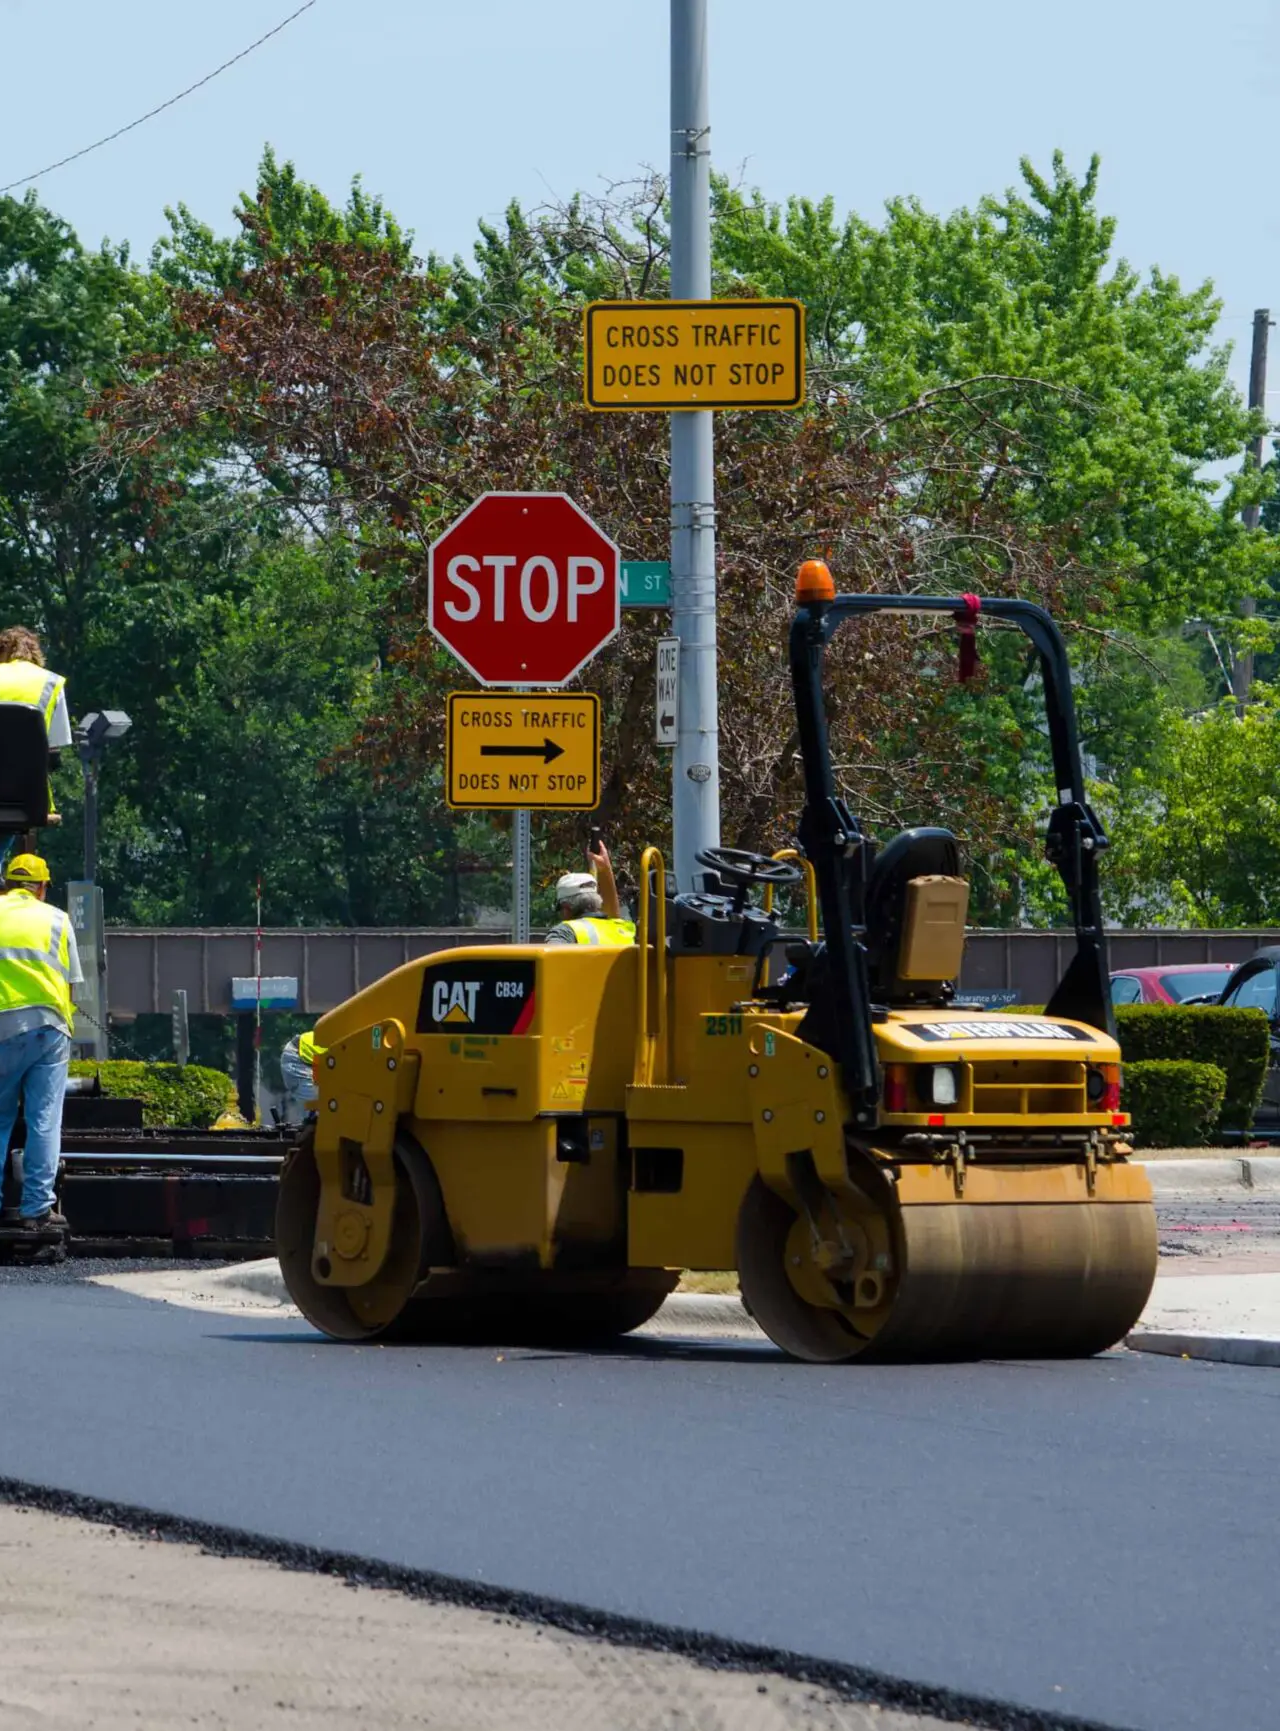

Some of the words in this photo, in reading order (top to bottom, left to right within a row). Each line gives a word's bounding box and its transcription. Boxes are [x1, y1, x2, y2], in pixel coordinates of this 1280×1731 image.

[606, 325, 679, 347] CROSS
[691, 324, 782, 346] TRAFFIC
[603, 364, 661, 387] DOES
[673, 364, 717, 386] NOT
[729, 363, 785, 385] STOP
[444, 554, 605, 623] STOP
[644, 575, 662, 590] ST
[659, 648, 676, 671] ONE
[659, 679, 676, 701] WAY
[461, 711, 513, 727] CROSS
[522, 711, 586, 728] TRAFFIC
[459, 774, 499, 790] DOES
[509, 774, 539, 790] NOT
[548, 775, 587, 791] STOP
[432, 980, 480, 1023] CAT
[495, 981, 524, 998] CB34
[706, 1015, 742, 1035] 2511
[922, 1022, 1077, 1040] CATERPILLAR
